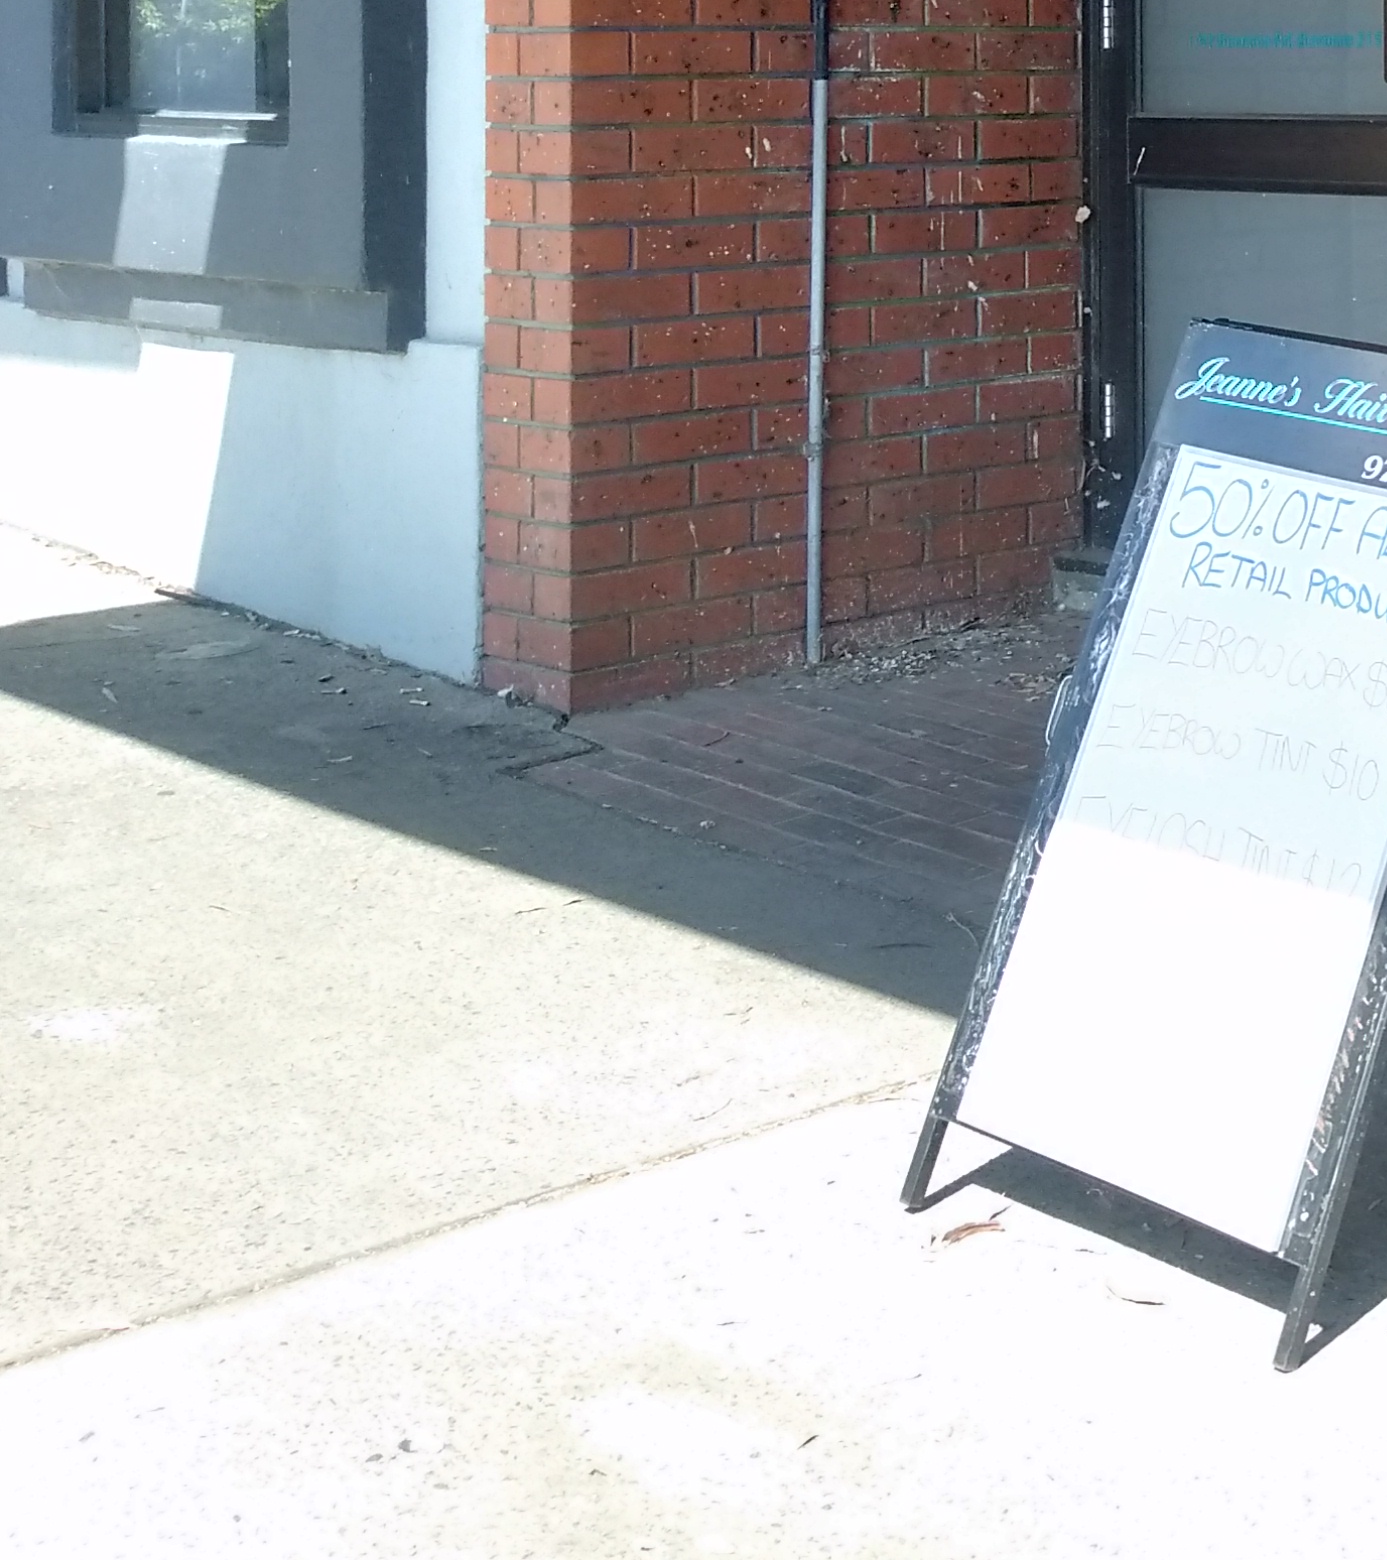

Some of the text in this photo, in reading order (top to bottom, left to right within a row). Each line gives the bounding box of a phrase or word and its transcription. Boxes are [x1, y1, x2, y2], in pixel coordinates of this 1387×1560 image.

[1174, 356, 1302, 407] Jeanne's
[1272, 489, 1356, 551] OFF
[1181, 540, 1292, 600] RETAIL
[1131, 608, 1285, 678] EYEBROW
[1287, 648, 1362, 692] WAX
[1095, 703, 1380, 801] EYEBROW TINT $10
